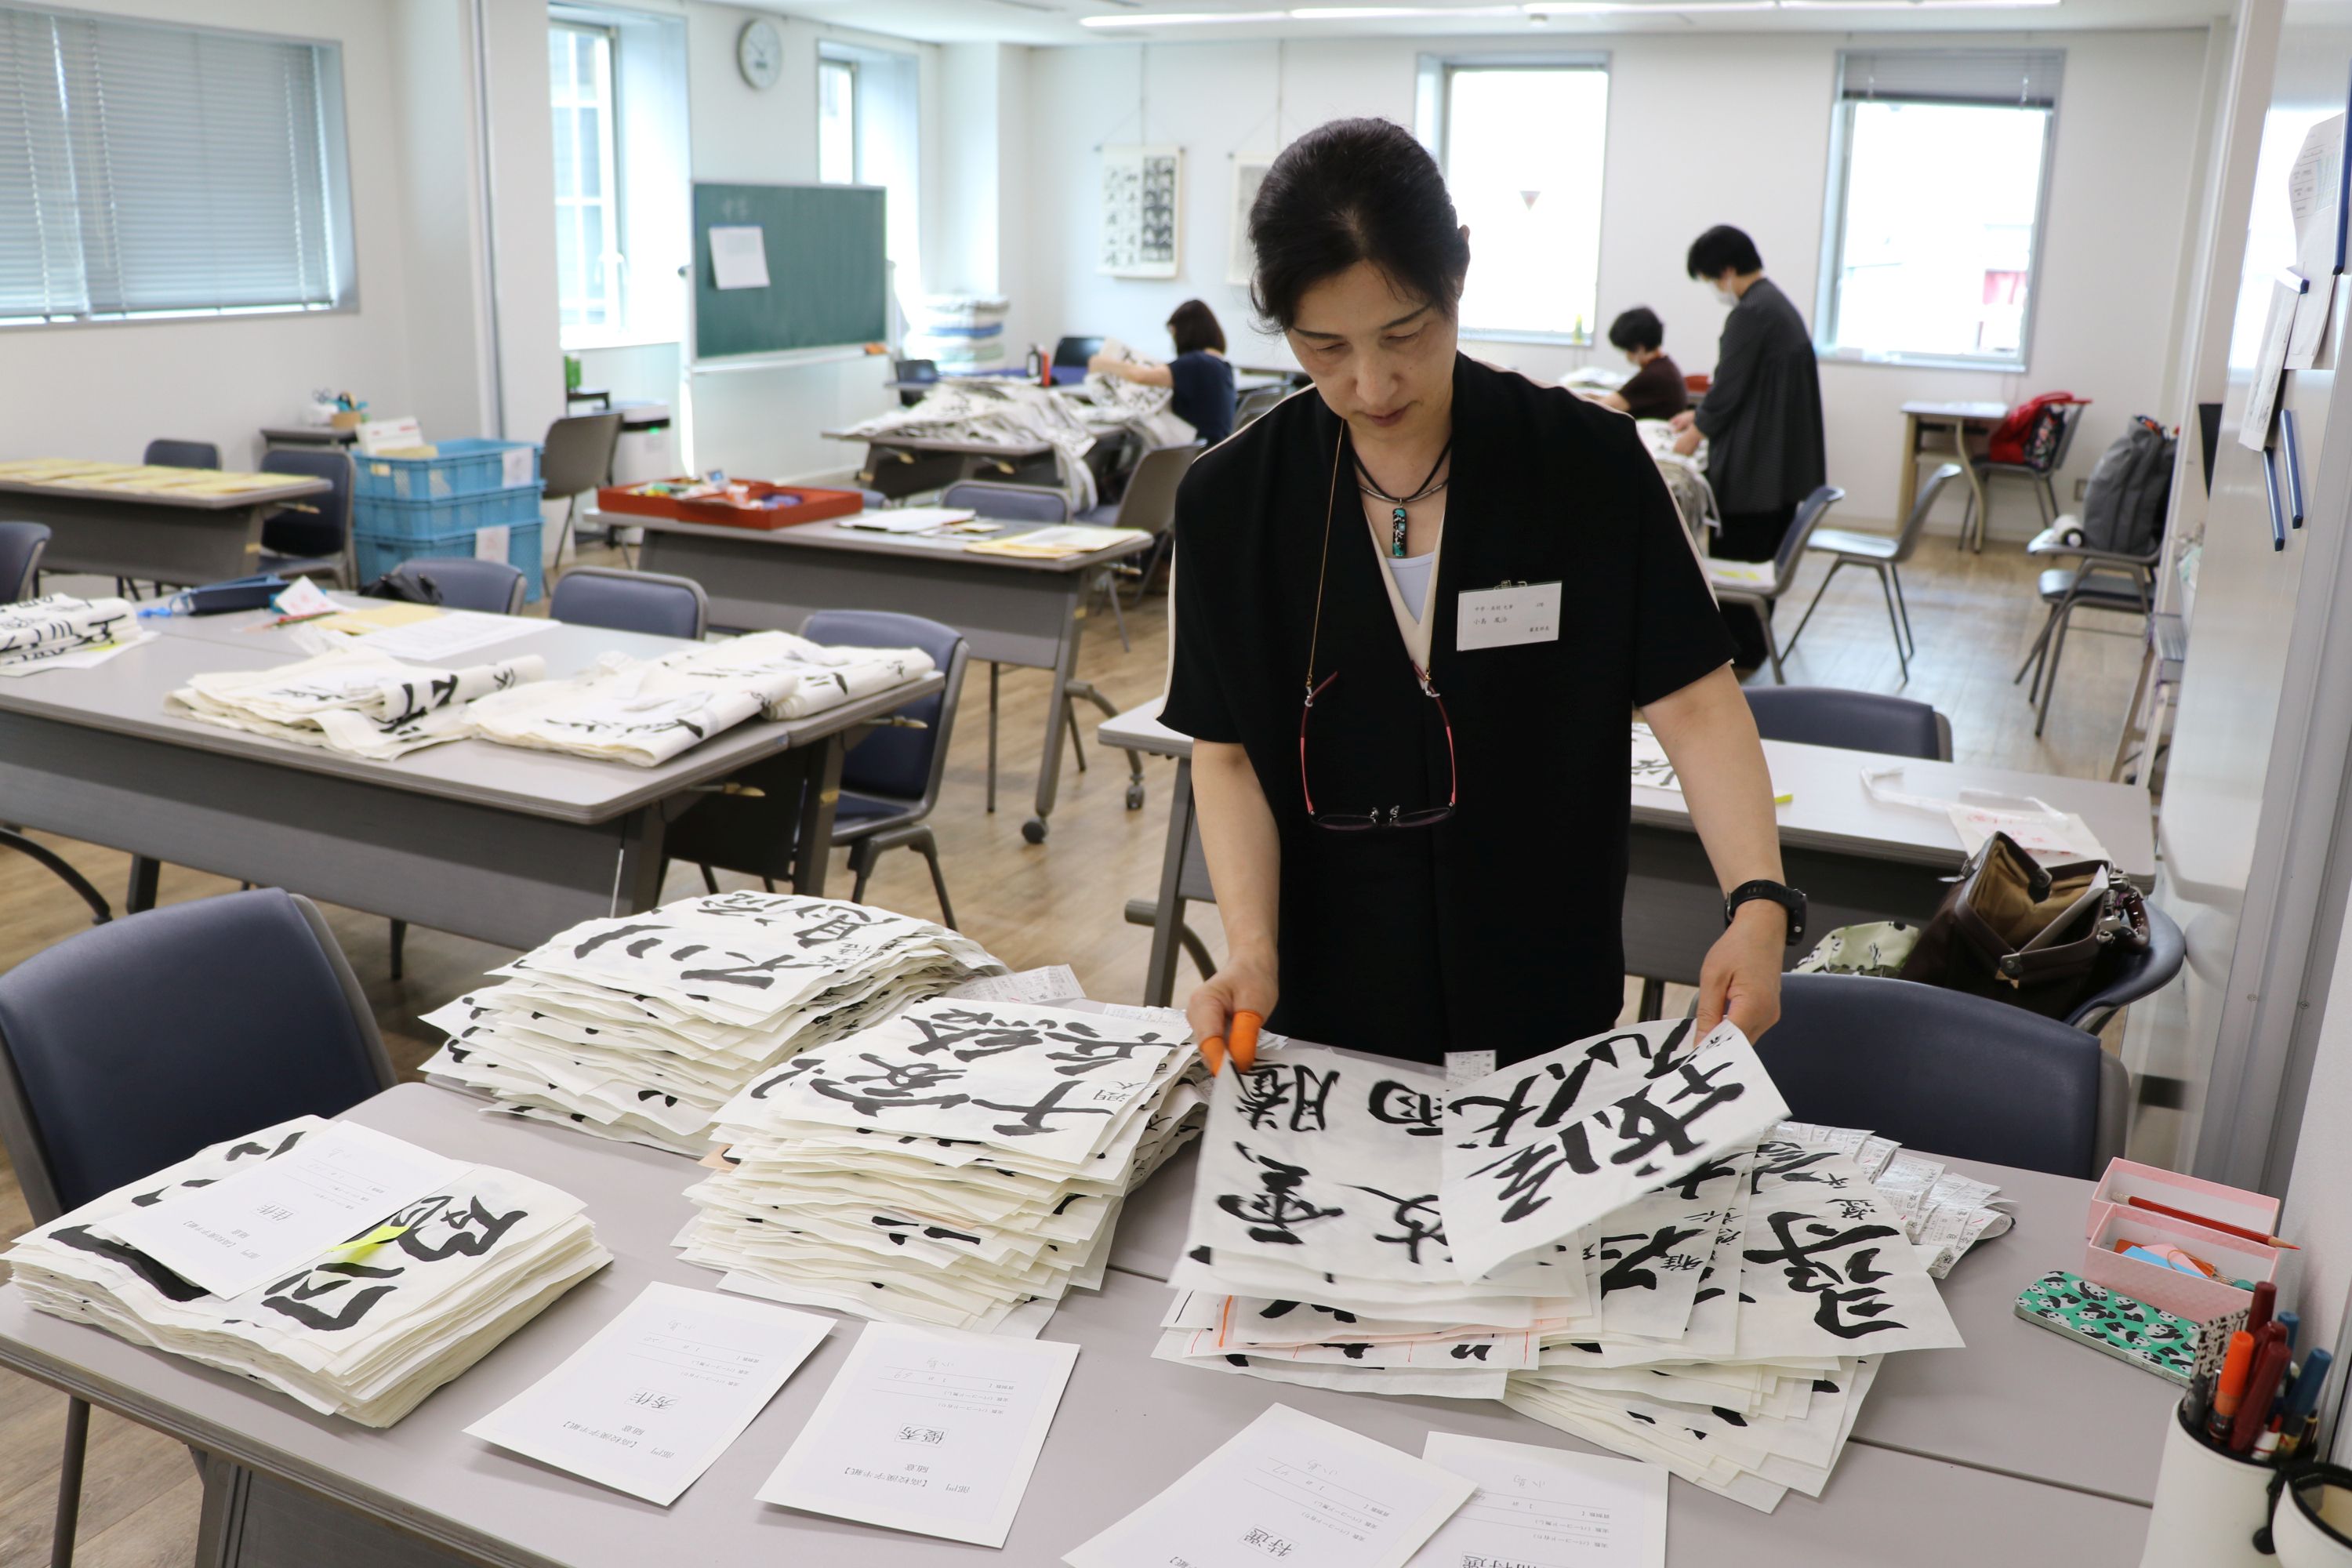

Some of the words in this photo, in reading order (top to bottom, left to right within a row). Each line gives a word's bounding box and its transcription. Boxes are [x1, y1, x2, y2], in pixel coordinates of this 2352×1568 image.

[1821, 1173, 1876, 1221] 遼平
[257, 1204, 293, 1222] 佳作
[630, 1392, 677, 1410] 秀作
[621, 1425, 645, 1436] 随意
[898, 1426, 945, 1444] 優秀
[650, 1447, 674, 1460] 部門
[904, 1463, 928, 1473] 随意
[946, 1483, 970, 1494] 部門
[1243, 1528, 1292, 1557] 特選
